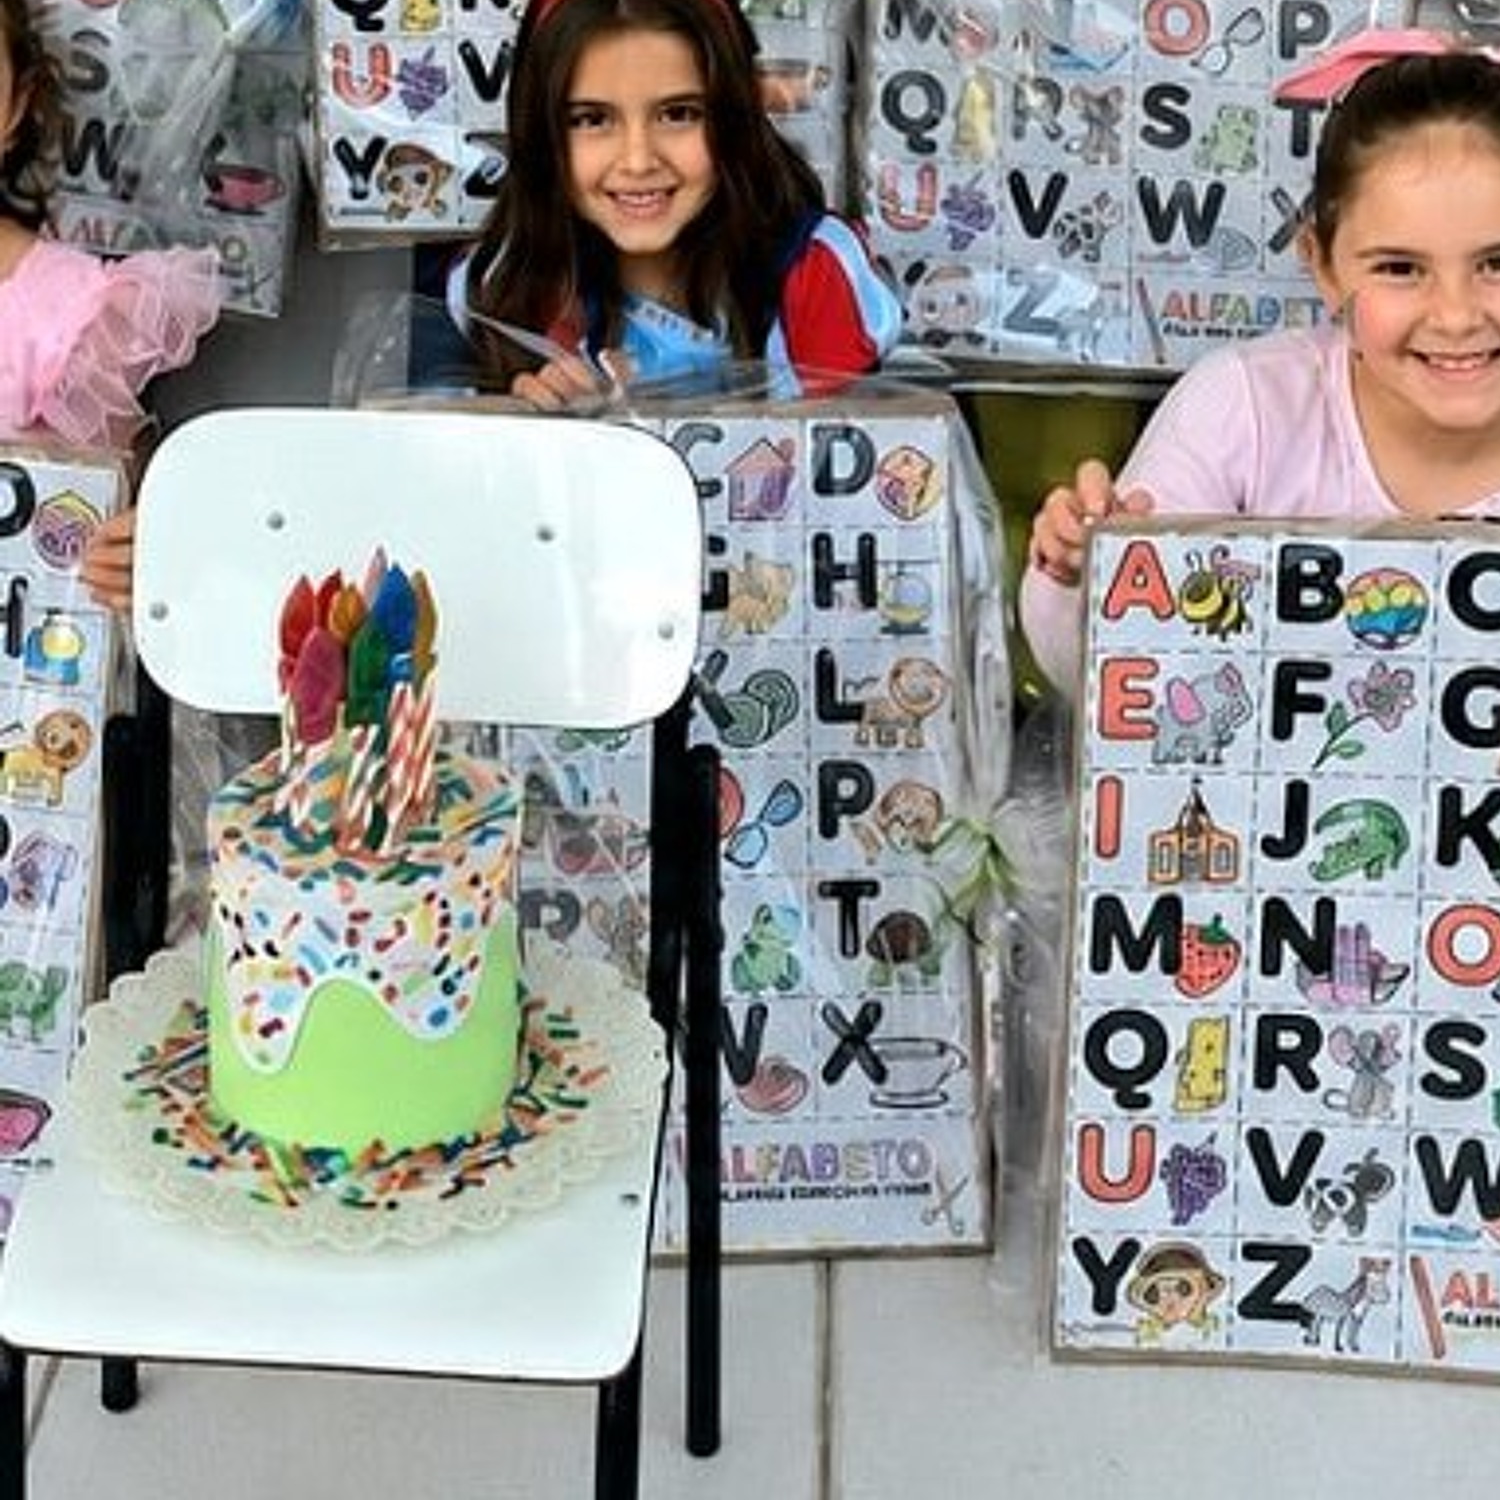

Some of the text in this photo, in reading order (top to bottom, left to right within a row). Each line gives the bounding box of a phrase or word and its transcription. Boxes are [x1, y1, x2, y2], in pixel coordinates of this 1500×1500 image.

[1279, 0, 1330, 59] P
[332, 42, 392, 105] U
[881, 70, 1192, 154] Q S
[333, 136, 387, 199] Y
[879, 164, 1226, 248] U V W
[1161, 288, 1325, 328] ALFABET
[810, 424, 875, 495] D
[810, 532, 877, 612] H
[1101, 541, 1174, 623] A
[1276, 544, 1342, 625] B
[814, 649, 866, 723] L
[1098, 658, 1158, 740] E
[1271, 662, 1331, 740] F
[818, 760, 874, 841] P
[1095, 776, 1123, 859] I
[1260, 780, 1310, 859] J
[818, 878, 881, 960] T
[1089, 895, 1183, 976] M
[1259, 898, 1335, 977] N
[821, 999, 887, 1086] X
[1083, 1010, 1169, 1109] Q
[1253, 1013, 1323, 1093] R
[1420, 1022, 1487, 1101] S
[722, 1139, 933, 1183] LFABETO
[1078, 1123, 1155, 1203] U
[1245, 1128, 1325, 1207] V
[1072, 1236, 1313, 1328] Y Z
